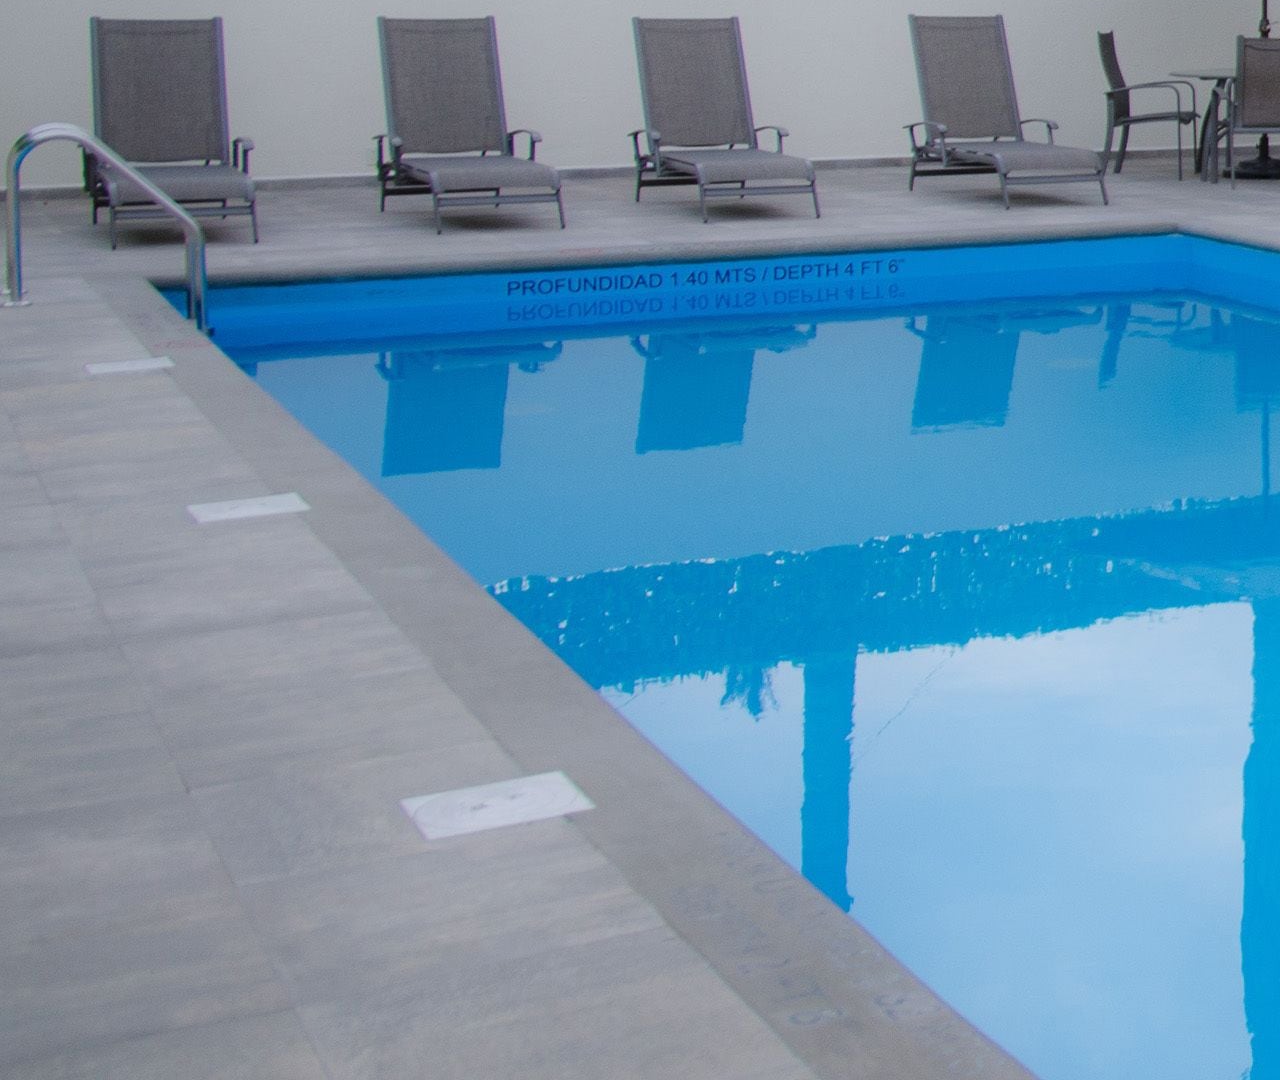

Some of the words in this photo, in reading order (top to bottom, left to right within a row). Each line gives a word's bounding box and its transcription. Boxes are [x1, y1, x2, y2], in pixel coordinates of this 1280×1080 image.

[507, 273, 663, 296] PROFUNDIDAD
[715, 269, 756, 284] MTS
[761, 267, 769, 281] /
[774, 263, 839, 281] DEPTH
[844, 262, 854, 278] 4
[861, 259, 884, 275] FT
